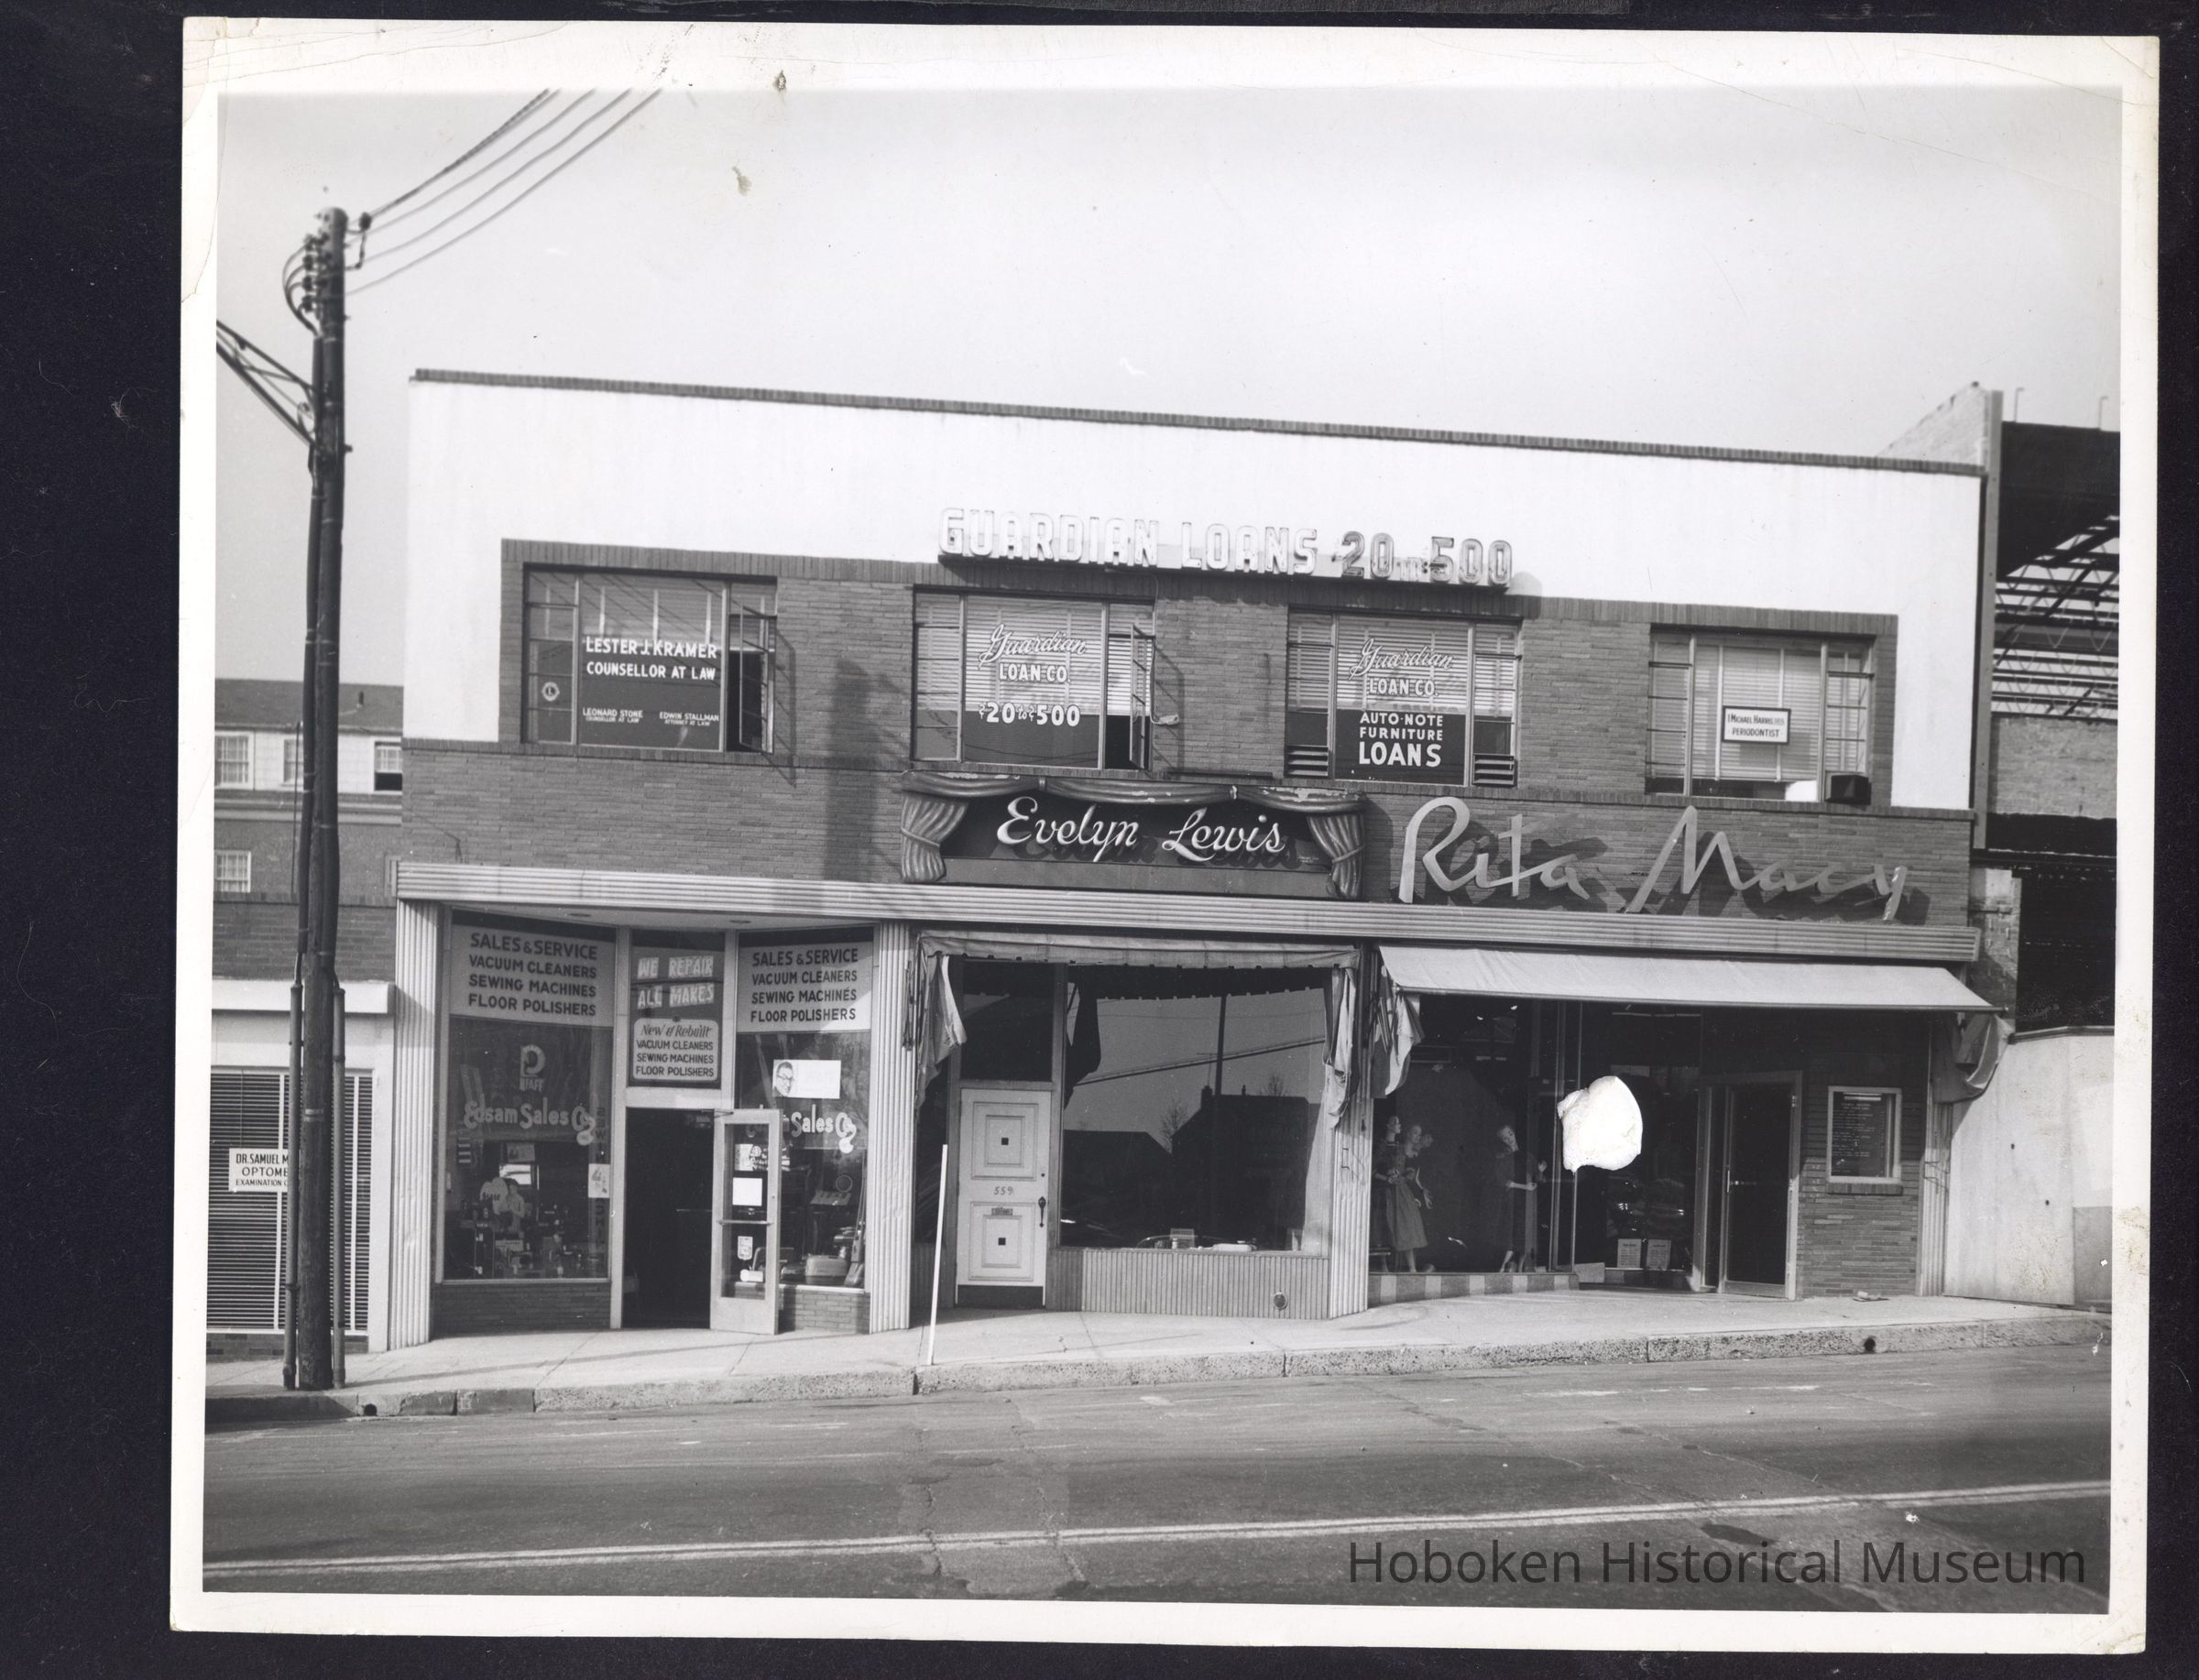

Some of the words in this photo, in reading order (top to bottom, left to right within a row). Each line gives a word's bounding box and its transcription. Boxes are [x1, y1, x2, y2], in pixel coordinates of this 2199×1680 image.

[938, 507, 1158, 567] GUARDIAN
[1181, 522, 1317, 574] LOANS
[585, 635, 638, 655] LESTER
[652, 639, 717, 659] KRAMER
[979, 624, 1087, 668] Guardian
[1348, 638, 1454, 681] Guardian
[586, 660, 666, 678] COUNSELLOR
[671, 666, 686, 680] AT
[691, 667, 717, 681] LAW
[1000, 663, 1041, 682] LOAN
[1369, 678, 1409, 695] LOAN
[583, 707, 618, 717] LEONARD
[619, 709, 643, 718] STONE
[659, 712, 683, 720] EDWIN
[684, 713, 719, 722] STALLMAN
[1360, 726, 1443, 741] FURNITURE
[1359, 741, 1442, 768] LOANS
[997, 795, 1139, 863] Evelyn
[1161, 806, 1285, 863] Lewis
[1399, 796, 1590, 904] Rita
[1625, 805, 1908, 922] Macy
[470, 933, 521, 954] SALES
[523, 942, 532, 954] &
[534, 940, 598, 961] SERVICE
[752, 951, 793, 967] SALES
[796, 954, 804, 965] &
[805, 948, 859, 965] SERVICE
[469, 954, 524, 973] VACUUM
[527, 961, 597, 979] CLEANERS
[638, 957, 659, 978] WE
[669, 956, 714, 978] REPAIR
[469, 974, 524, 992] SEWING
[529, 980, 596, 998] MACHINES
[752, 971, 798, 986] VACUUM
[802, 969, 858, 984] CLEANERS
[468, 993, 518, 1011] FLOOR
[523, 998, 596, 1017] POLISHERS
[670, 984, 714, 1007] MAKES
[751, 991, 794, 1005] SEWING
[799, 988, 858, 1002] MACHINES
[750, 1009, 788, 1023] FLOOR
[791, 1008, 857, 1022] POLISHERS
[641, 1024, 666, 1037] New
[674, 1023, 713, 1038] Rebuilt
[636, 1040, 671, 1050] VACUUM
[673, 1040, 714, 1051] CLEANERS
[637, 1053, 668, 1064] SEWING
[670, 1053, 714, 1064] MACHINES
[636, 1065, 664, 1076] FLOOR
[668, 1066, 715, 1077] POLISHERS
[520, 1096, 570, 1129] Sales
[791, 1103, 834, 1138] Sales
[249, 1153, 279, 1164] SAMUEL
[993, 1185, 1013, 1195] 559
